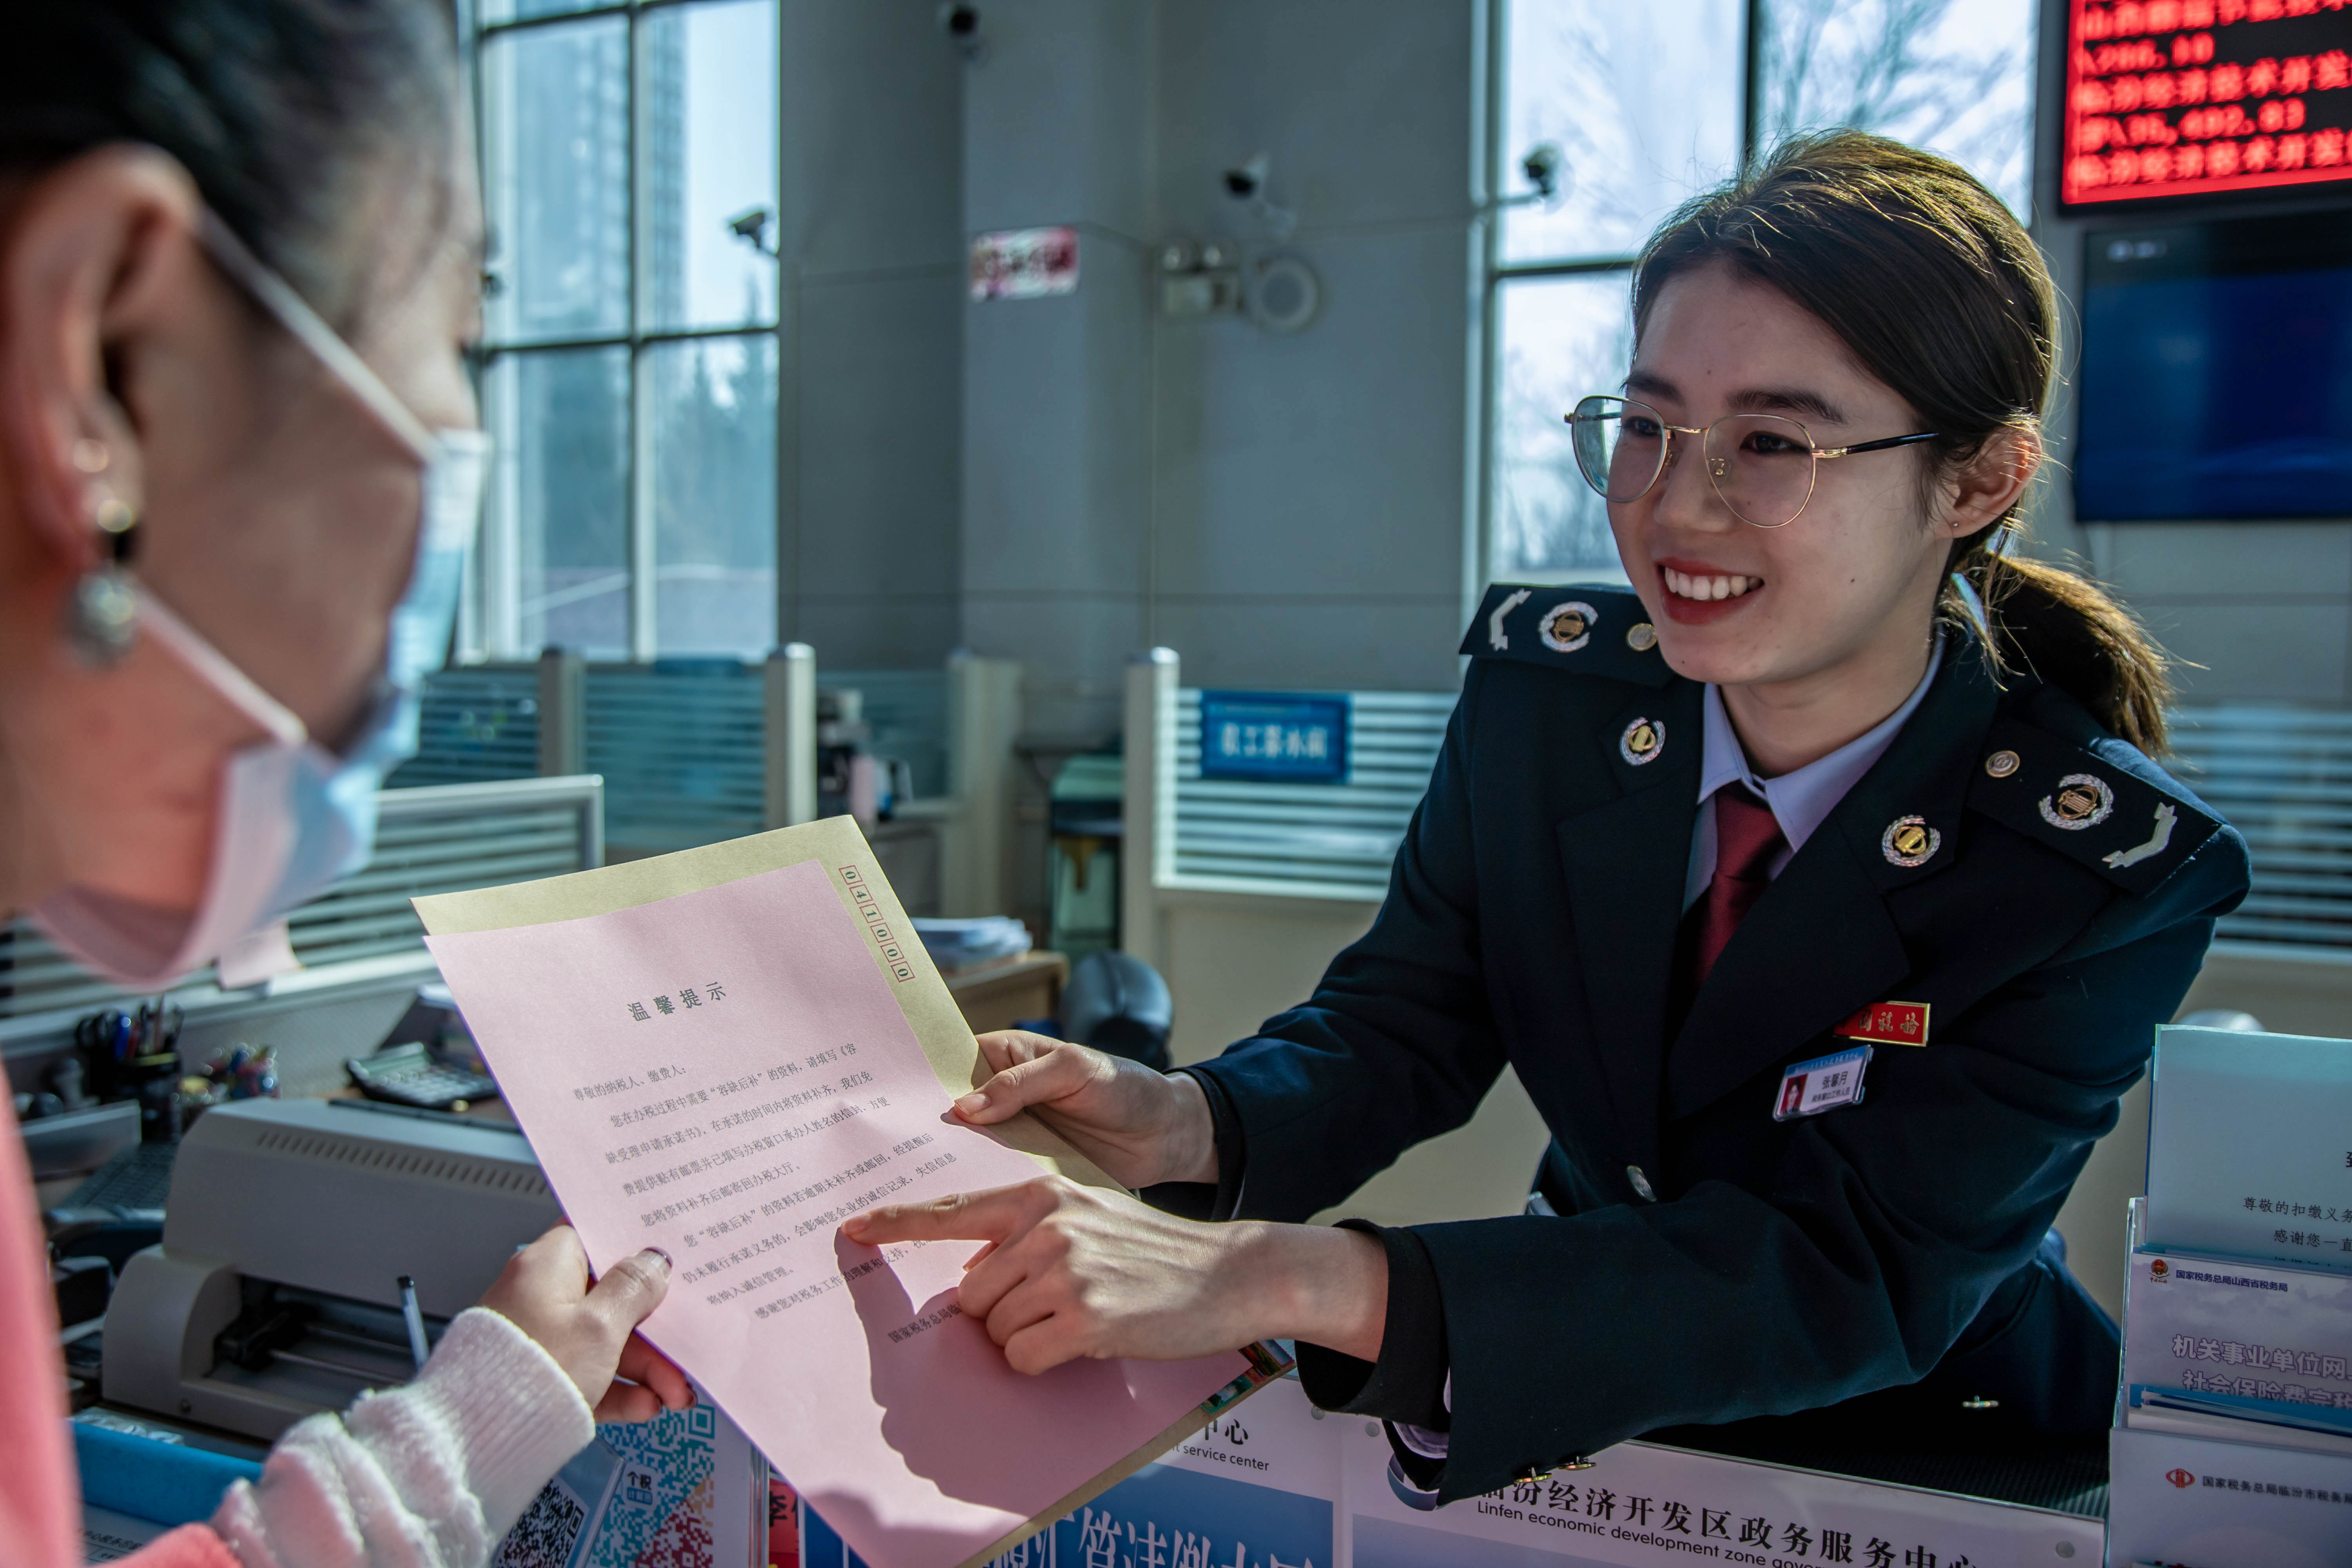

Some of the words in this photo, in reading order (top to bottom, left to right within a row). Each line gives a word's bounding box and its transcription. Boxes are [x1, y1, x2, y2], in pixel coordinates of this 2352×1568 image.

[845, 871, 909, 977] 041000
[628, 982, 726, 1021] 温馨提示
[2176, 1270, 2288, 1292] 国家税务总局山西省税务局
[887, 1301, 962, 1343] 国家税务总局临
[2172, 1334, 2352, 1380] 机关事业单位网
[1183, 1445, 1227, 1462] service
[1230, 1455, 1270, 1471] center
[1478, 1501, 1523, 1520] Linfen
[1528, 1514, 1605, 1536] economic
[1611, 1526, 1720, 1558] development
[1725, 1549, 1766, 1566] zone
